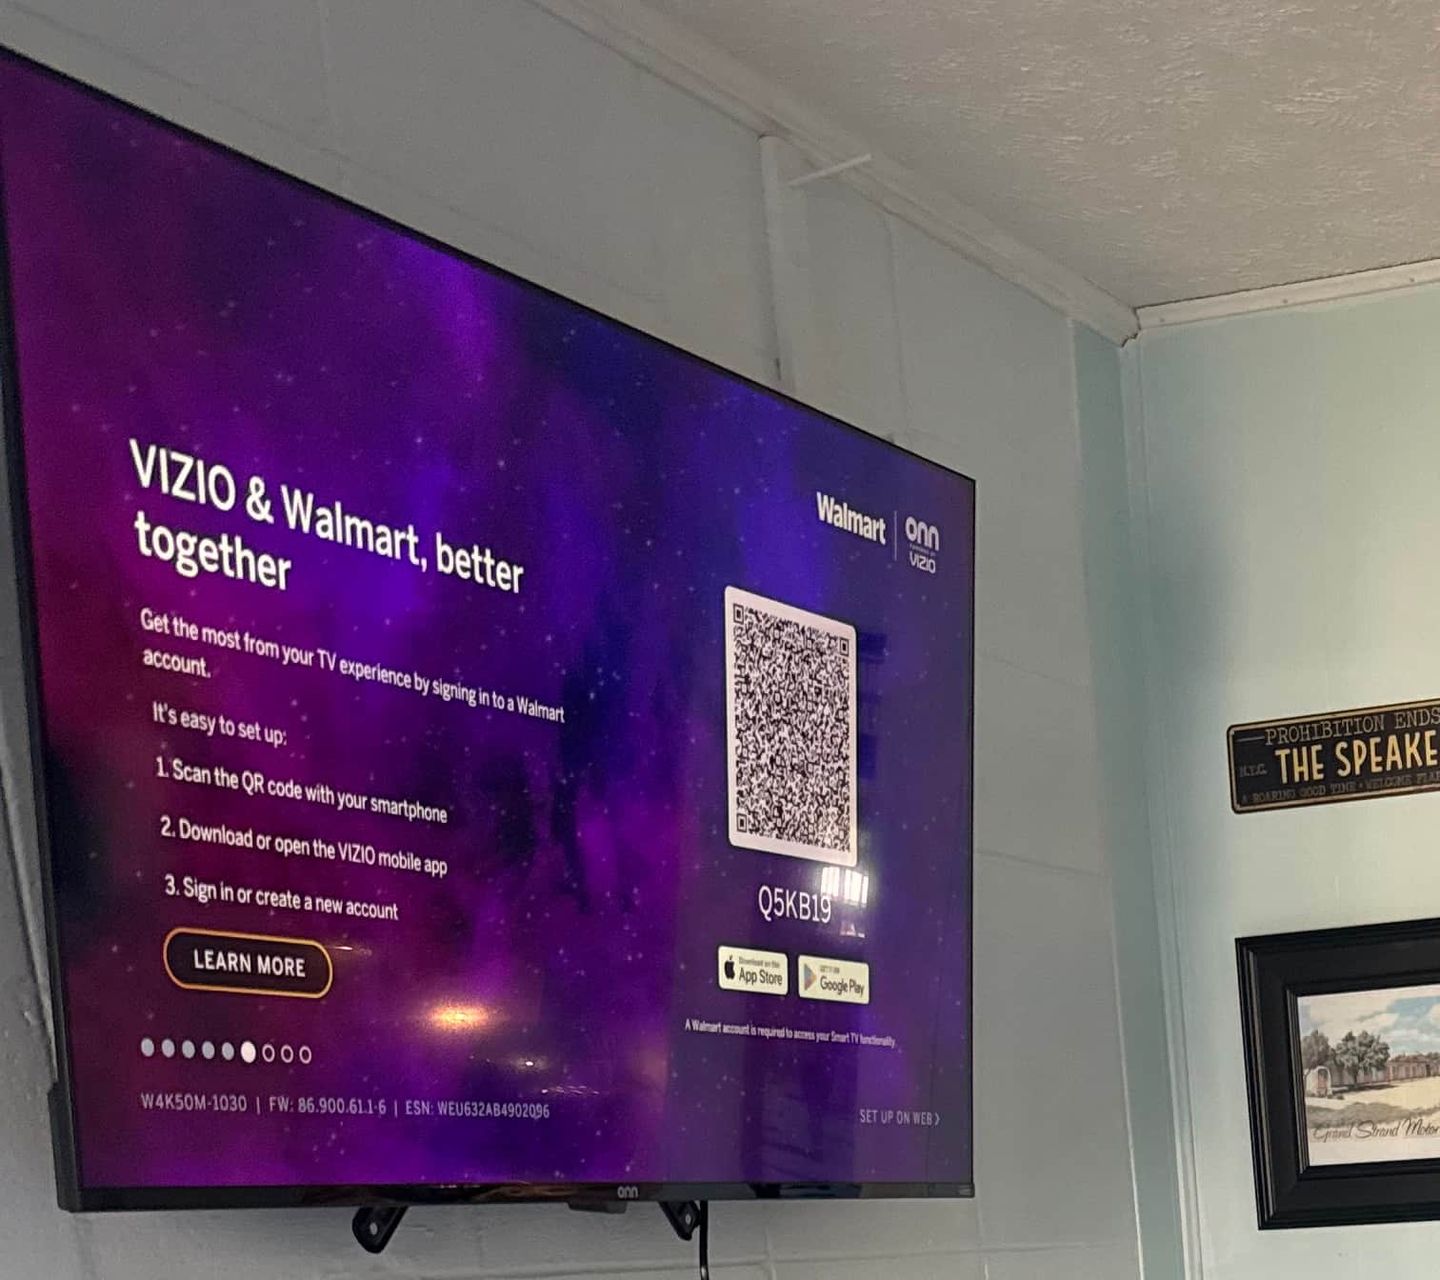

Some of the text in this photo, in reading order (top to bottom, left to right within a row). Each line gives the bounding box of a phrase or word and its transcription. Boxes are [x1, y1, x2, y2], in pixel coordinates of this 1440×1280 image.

[129, 438, 524, 593] VIZIO & Walmart, better
[816, 491, 886, 545] Walmart
[134, 510, 292, 591] together
[905, 516, 940, 552] onn
[909, 551, 936, 574] VIZIO
[140, 607, 565, 724] Get the most from your TV experience by signing in to a Walmart
[143, 647, 211, 679] account.
[152, 701, 287, 748] It's easy to set up:
[1265, 714, 1385, 746] PROHIBITION
[1274, 744, 1324, 784] THE
[156, 755, 448, 823] 1. Scan the QR code with your smartphone
[160, 814, 448, 879] 2. Download or open the VIZIO mobile app
[164, 873, 399, 921] 3. Sign in or create a new account
[758, 885, 832, 924] Q5KB19
[193, 948, 306, 978] LEARN MORE
[739, 967, 783, 987] App Store
[819, 975, 865, 997] Google Play
[140, 1092, 248, 1112] W4K50M-1030
[268, 1095, 294, 1113] FW:
[405, 1099, 434, 1116] ESN:
[860, 1108, 933, 1126] SET UP ON WEB
[1312, 1123, 1352, 1143] Grand
[1355, 1119, 1400, 1140] Strand
[1400, 1118, 1440, 1136] Motor
[617, 1185, 638, 1198] onn
